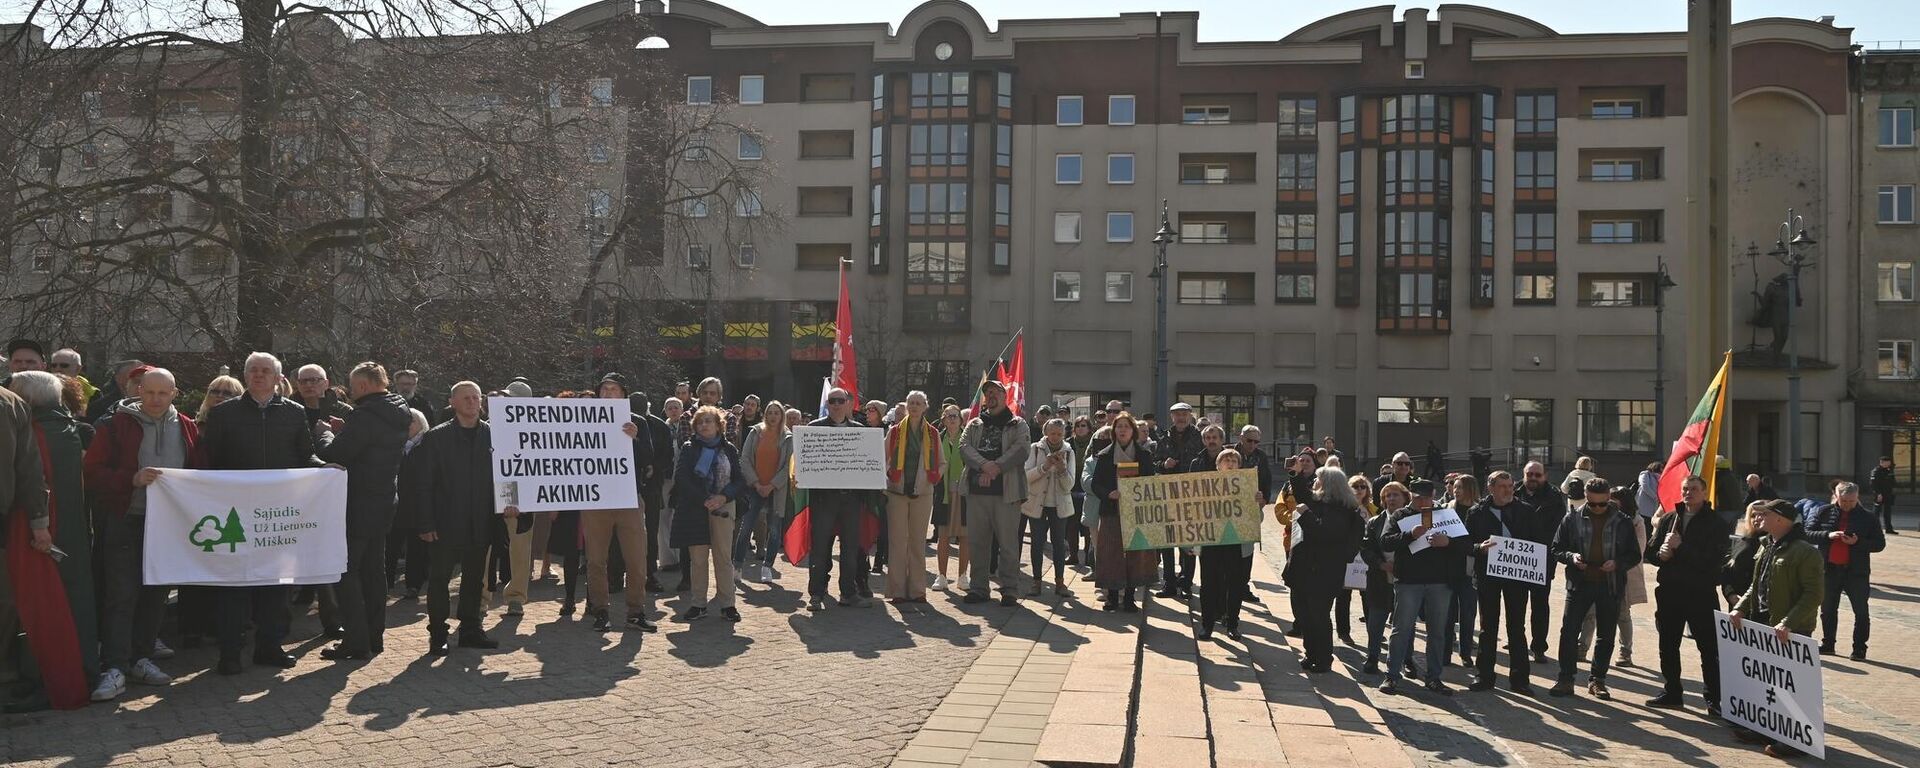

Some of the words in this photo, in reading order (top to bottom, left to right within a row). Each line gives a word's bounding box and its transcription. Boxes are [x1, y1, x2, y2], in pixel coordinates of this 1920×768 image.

[505, 405, 614, 423] SPRENDIMAI
[519, 432, 606, 449] PRIIMAMI
[500, 454, 628, 477] UŽMERKTOMIS
[537, 484, 600, 503] AKIMIS
[254, 506, 300, 520] Sąjūdis
[254, 523, 269, 533] Už
[273, 521, 318, 532] Lietuvos
[254, 536, 297, 548] Miškus
[1504, 540, 1515, 550] 14
[1517, 542, 1535, 554] 324
[1497, 549, 1538, 570] ŽMONIŲ
[1488, 564, 1544, 582] NEPRITARIA
[1742, 656, 1796, 693] GAMTA
[1730, 695, 1813, 746] SAUGUMAS
